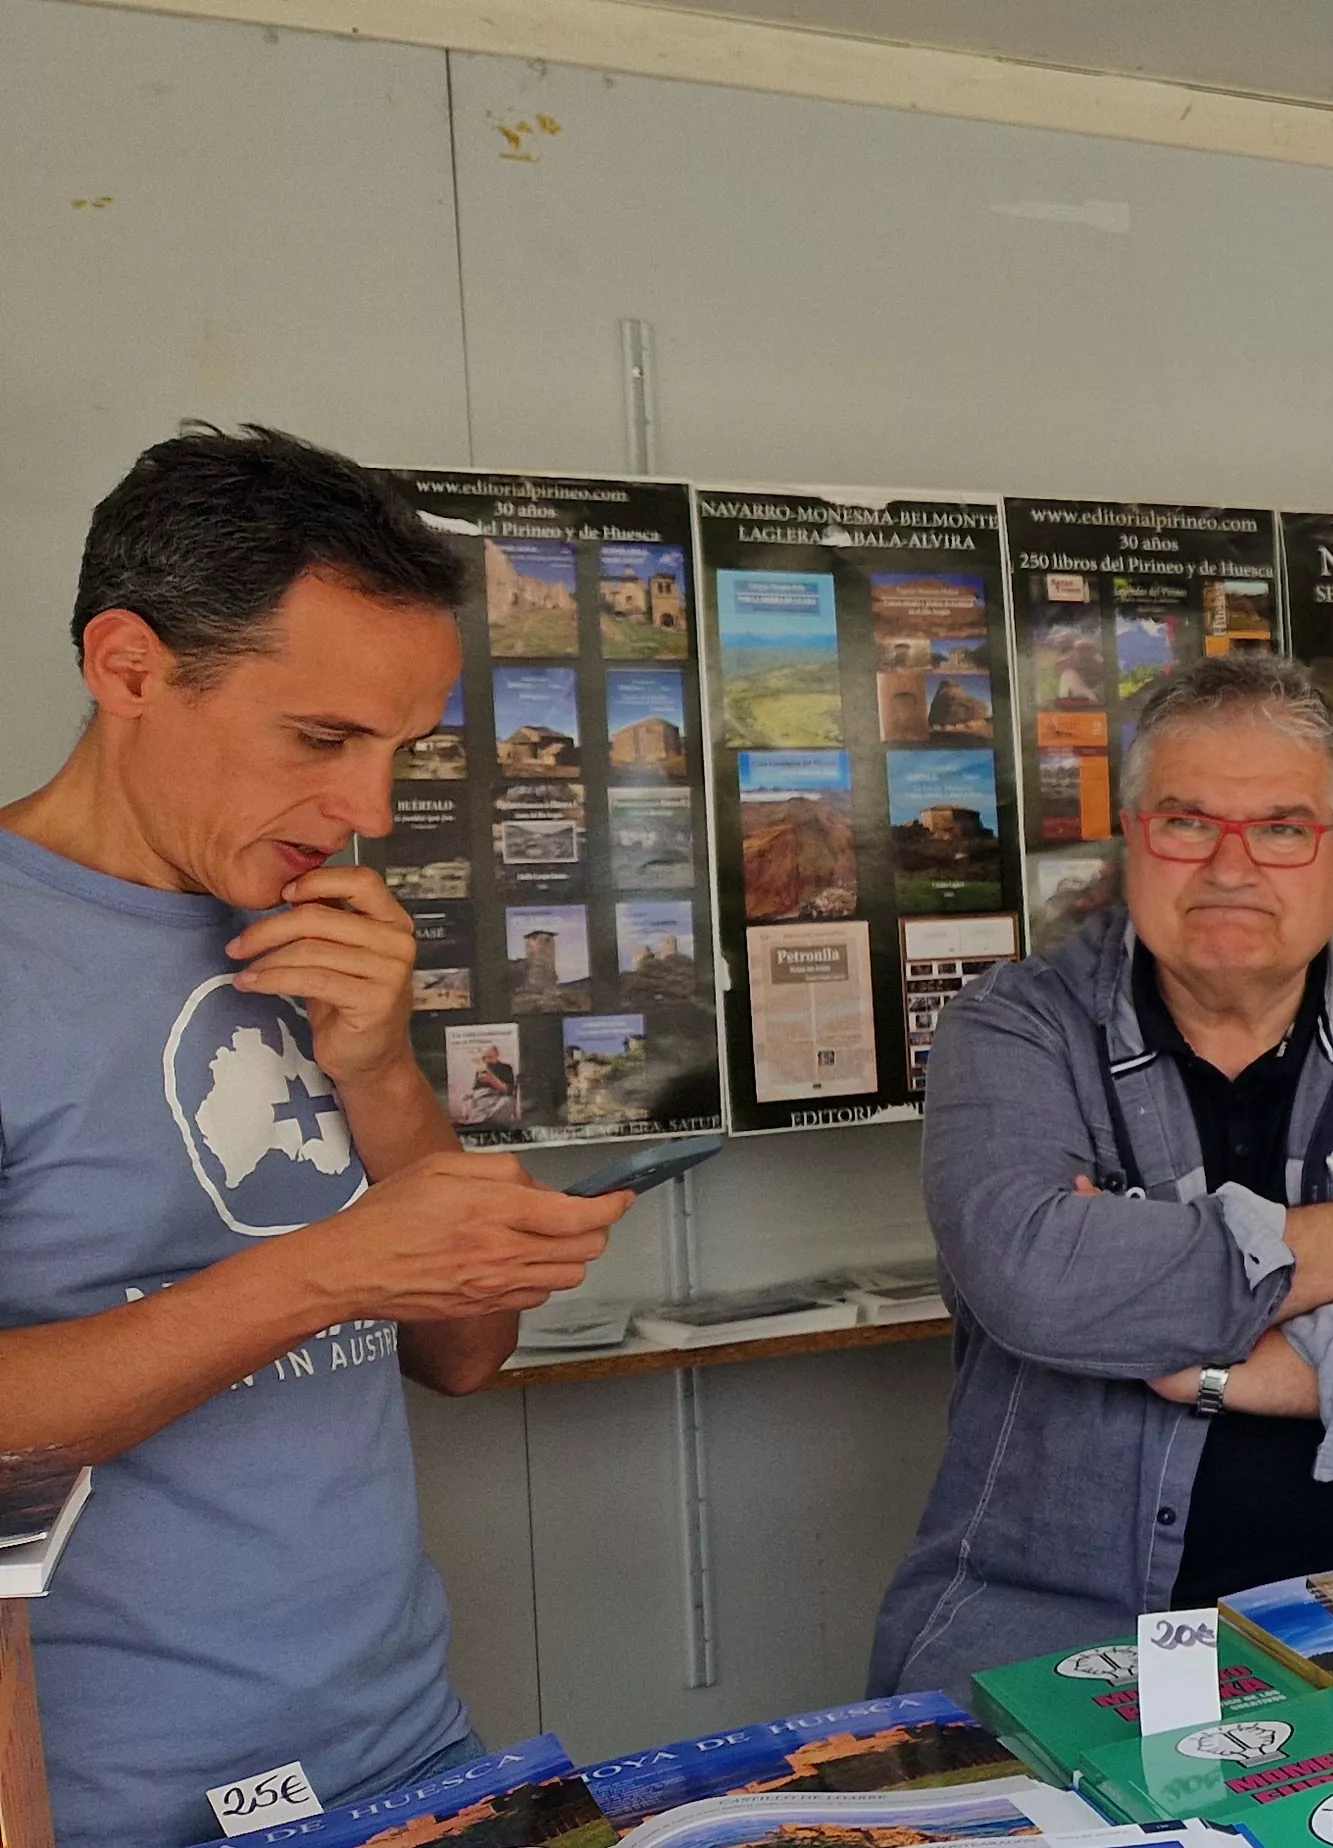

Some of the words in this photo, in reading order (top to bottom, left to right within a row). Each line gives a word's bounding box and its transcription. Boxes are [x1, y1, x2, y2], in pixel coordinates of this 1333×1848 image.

[416, 479, 630, 502] www.editorialpirineo.com
[493, 501, 514, 517] 30
[516, 502, 557, 519] años
[701, 501, 999, 529] NAVARRO-MONESMA-BELMONTE
[1030, 508, 1259, 532] www.editorialpirineo.com
[502, 520, 561, 538] Pirineo
[566, 526, 573, 541] y
[579, 523, 600, 538] de
[602, 524, 661, 542] Huesca
[1119, 534, 1139, 551] 30
[1142, 534, 1180, 552] años
[1019, 552, 1050, 570] 250
[1052, 552, 1097, 572] libros
[1101, 556, 1124, 573] del
[1129, 557, 1184, 576] Pirineo
[1187, 562, 1195, 578] y
[1199, 560, 1217, 577] de
[1220, 561, 1275, 580] Huesca
[669, 1114, 720, 1132] SATUÉ
[790, 1103, 893, 1129] EDITORIA
[274, 1349, 314, 1381] IN
[695, 1730, 751, 1752] DE
[767, 1698, 923, 1735] HUESCA
[264, 1819, 327, 1844] DE
[350, 1754, 525, 1821] HUESCA
